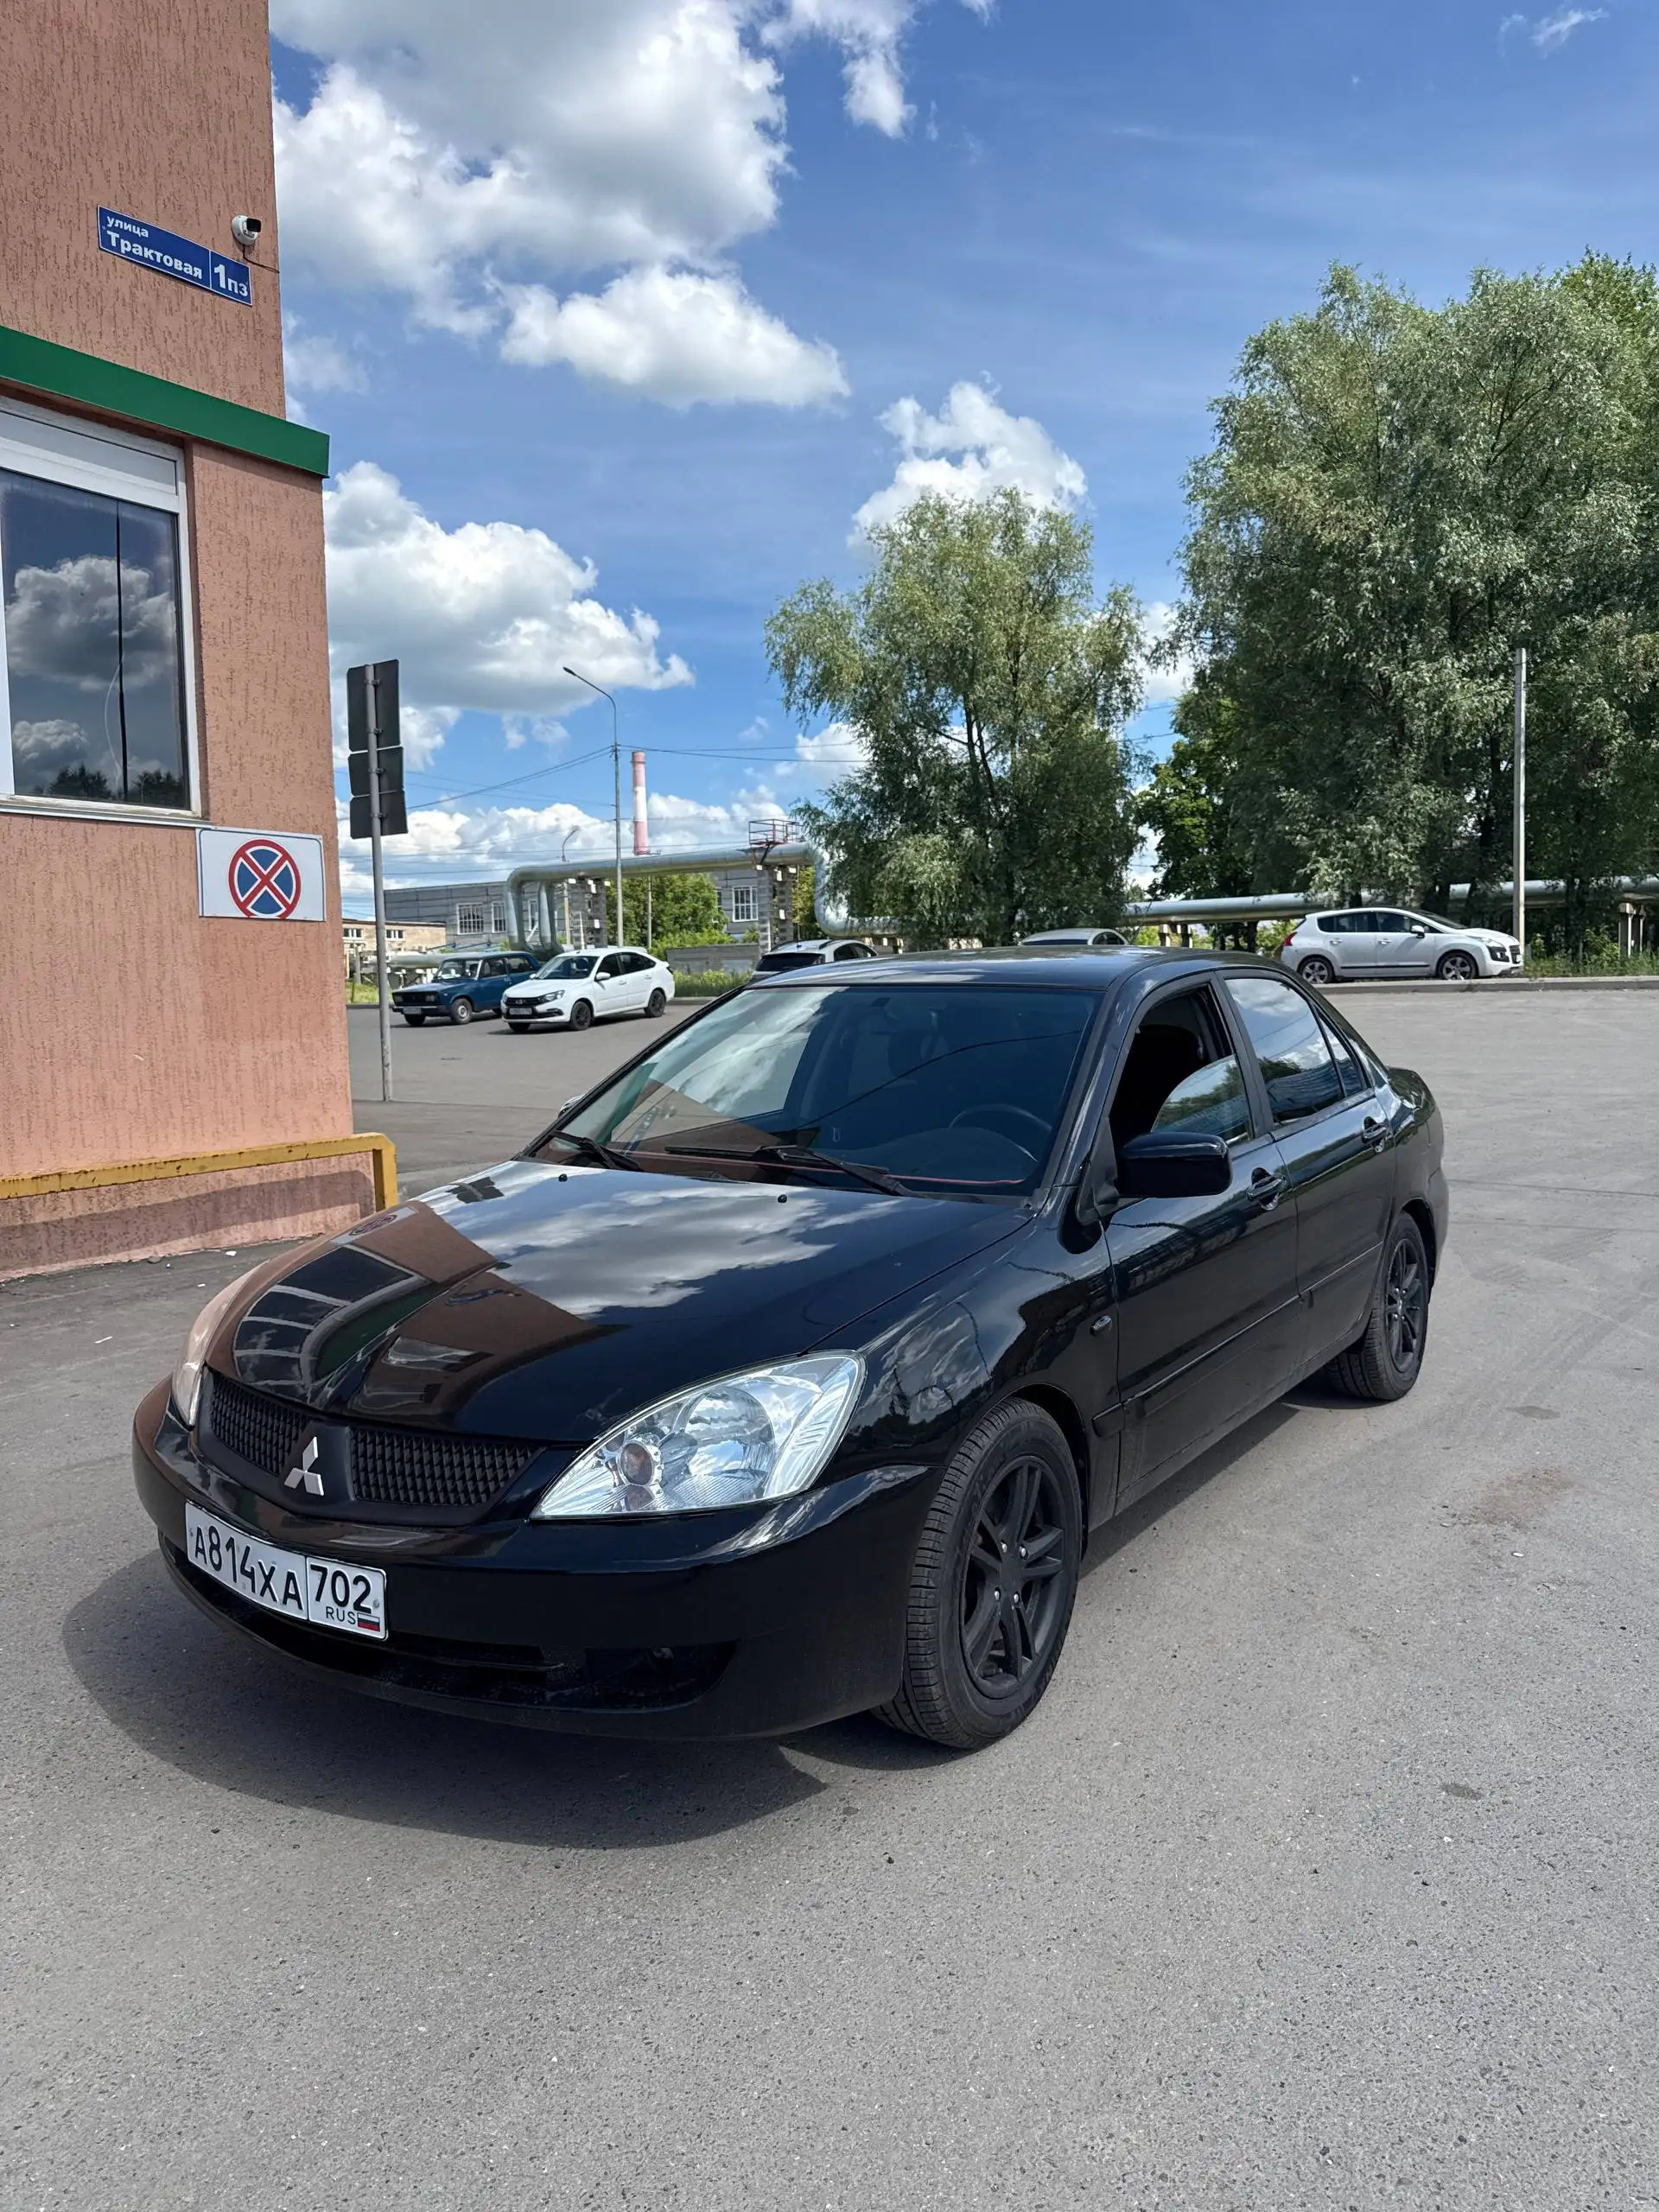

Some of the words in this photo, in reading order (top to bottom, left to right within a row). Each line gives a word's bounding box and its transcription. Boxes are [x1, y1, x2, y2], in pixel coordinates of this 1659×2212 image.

[106, 216, 149, 238] улица
[106, 230, 203, 280] Трактовая
[310, 1564, 372, 1615] 702
[326, 1605, 357, 1626] RUS
